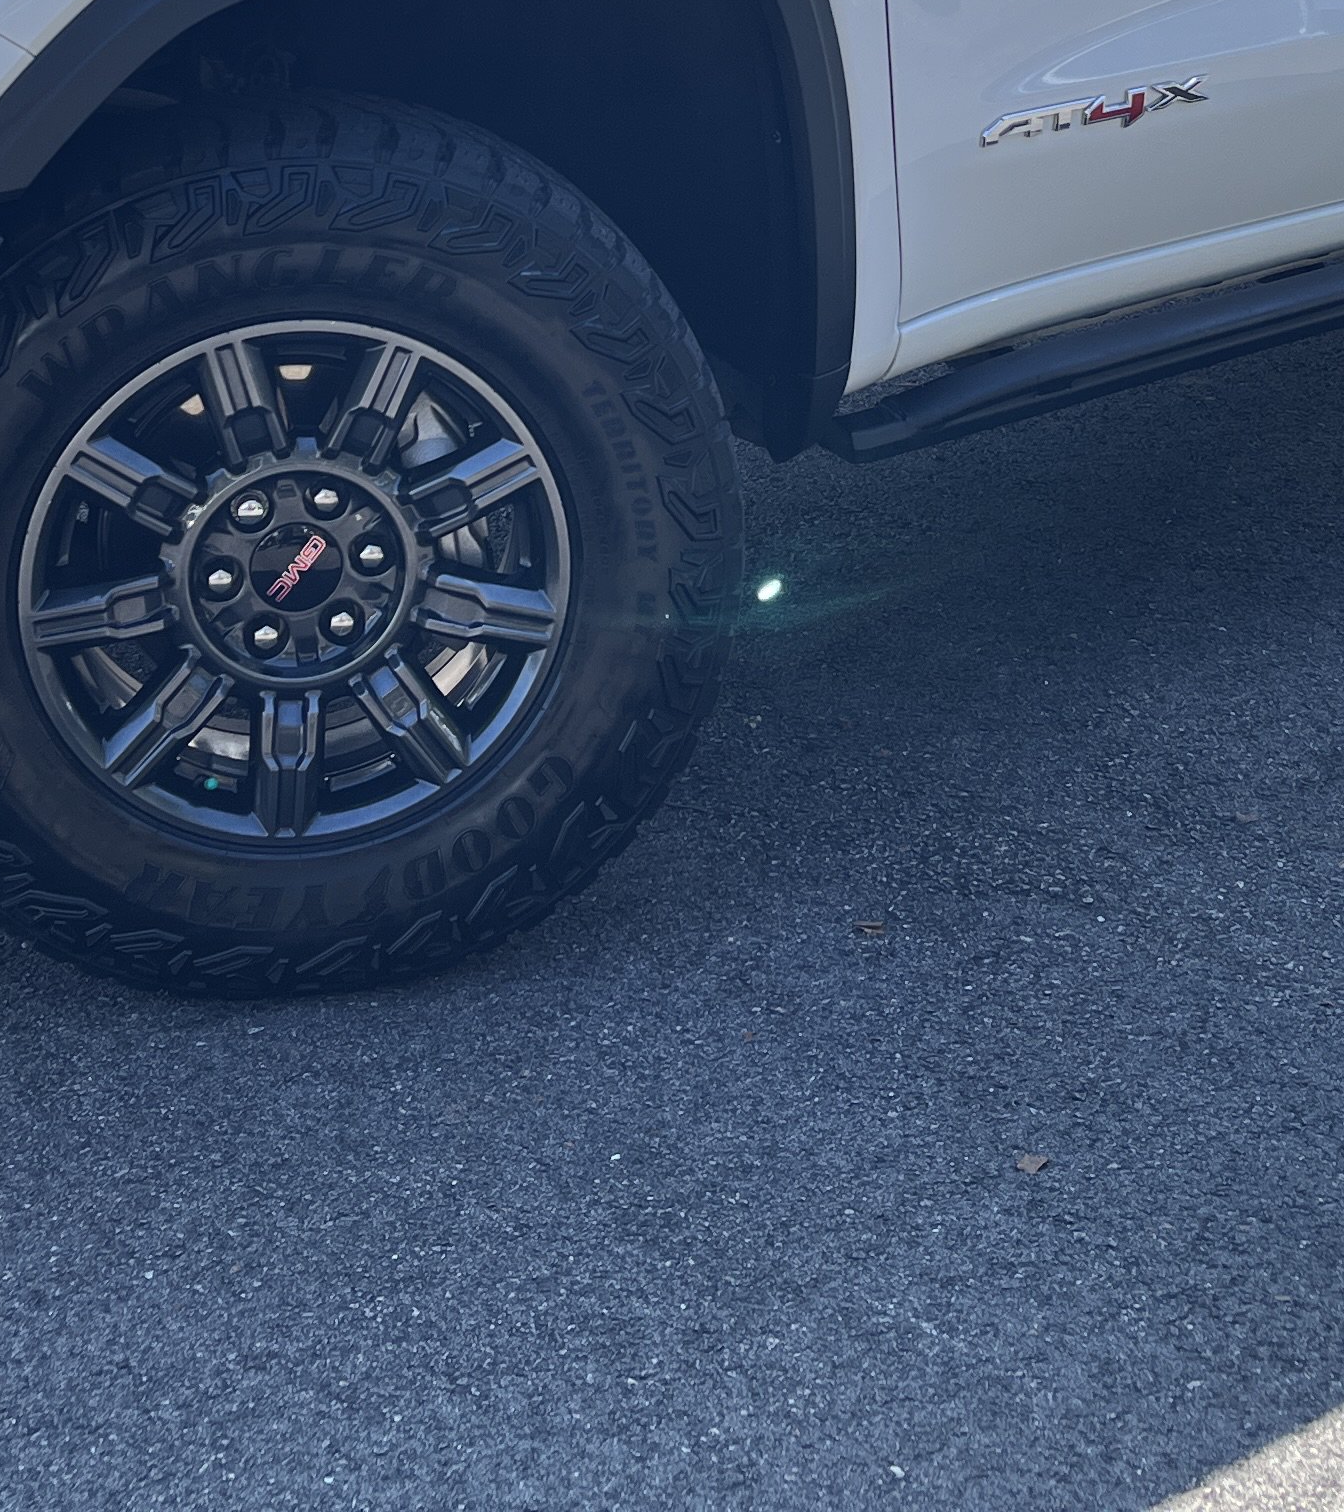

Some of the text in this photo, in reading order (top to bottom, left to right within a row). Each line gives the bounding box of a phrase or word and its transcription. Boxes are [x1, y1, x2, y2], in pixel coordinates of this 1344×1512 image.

[979, 73, 1210, 148] AT4X
[16, 245, 462, 402] WRANGLER
[266, 535, 327, 603] GMC
